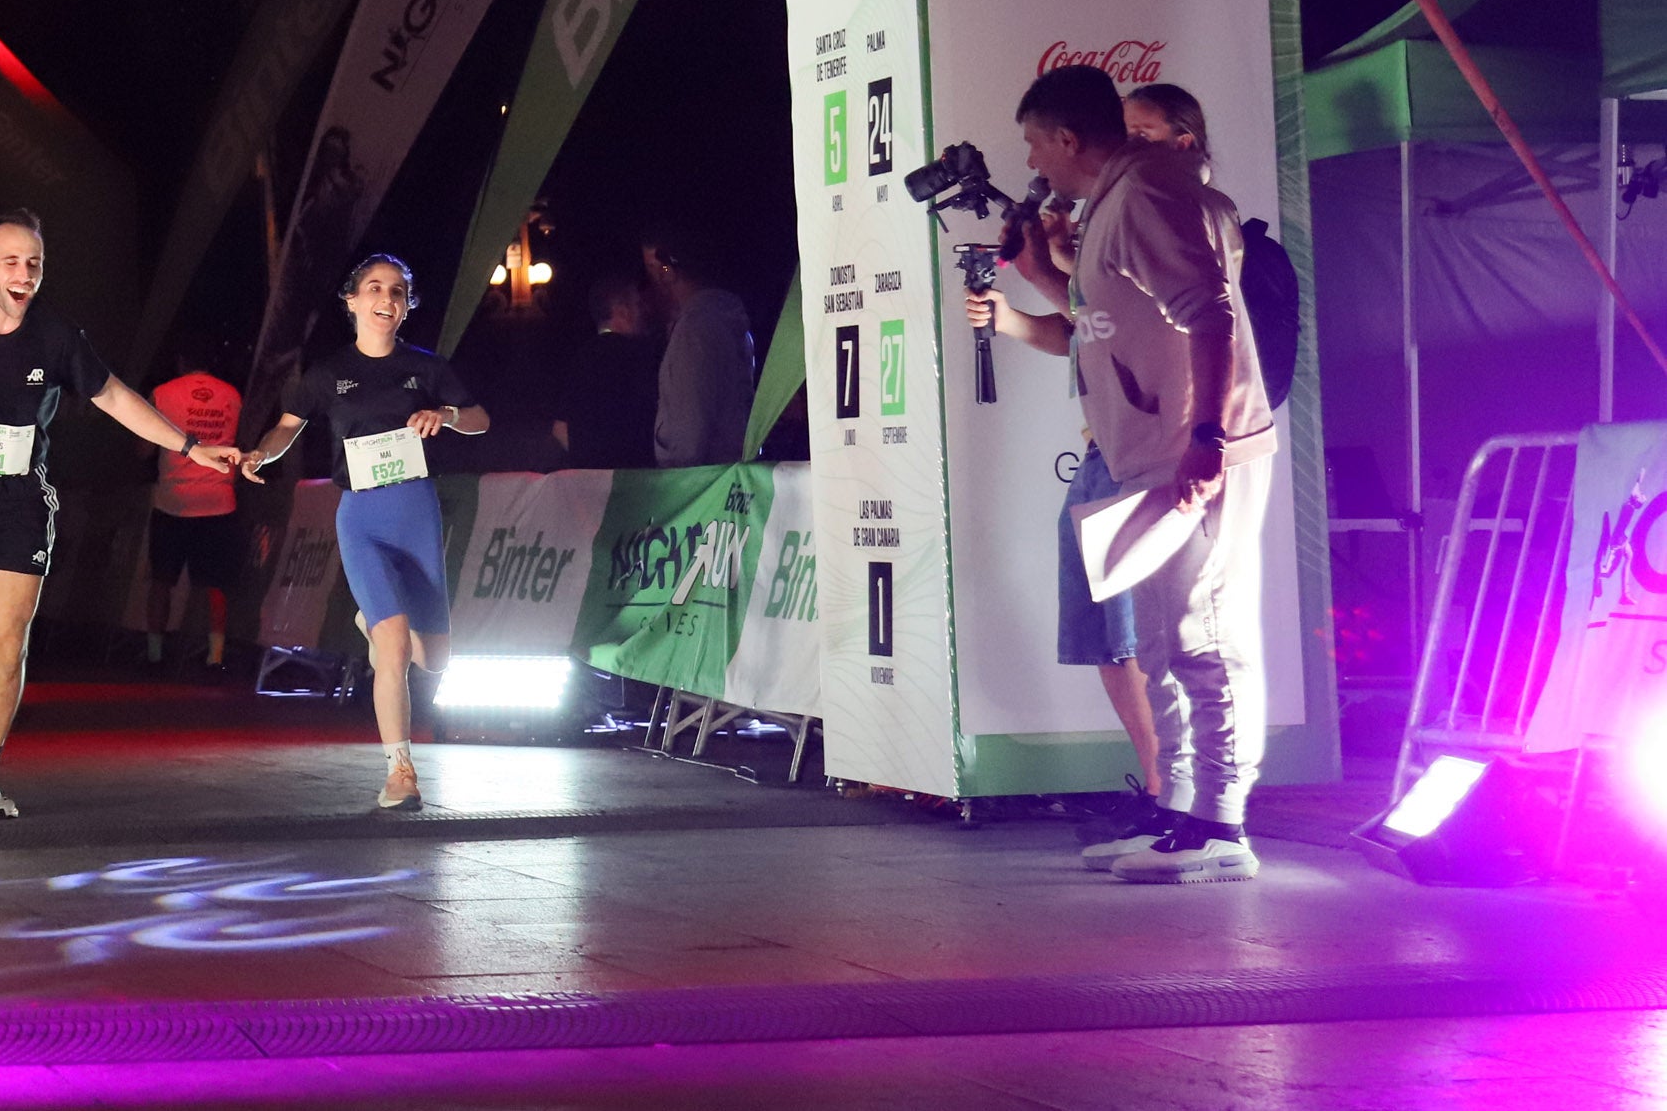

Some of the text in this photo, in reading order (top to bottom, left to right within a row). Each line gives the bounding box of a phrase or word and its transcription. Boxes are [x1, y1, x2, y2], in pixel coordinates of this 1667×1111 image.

[816, 33, 832, 56] SANTA
[867, 30, 885, 53] PALMA
[816, 56, 847, 82] DE TENERIFE
[829, 105, 842, 174] 5
[868, 92, 893, 165] 24
[830, 264, 856, 286] DONOSTIA
[874, 270, 902, 293] ZARAGOZA
[824, 295, 835, 314] SAN
[1074, 310, 1117, 344] as
[841, 340, 853, 407] 7
[881, 334, 904, 404] 27
[371, 459, 406, 481] F522
[723, 481, 756, 516] Binter
[859, 500, 893, 520] LAS PALMAS
[853, 527, 901, 548] DE GRAN CANARIA
[474, 525, 576, 604] Binter
[877, 576, 884, 644] 1
[871, 666, 895, 686] NOVIEMBRE
